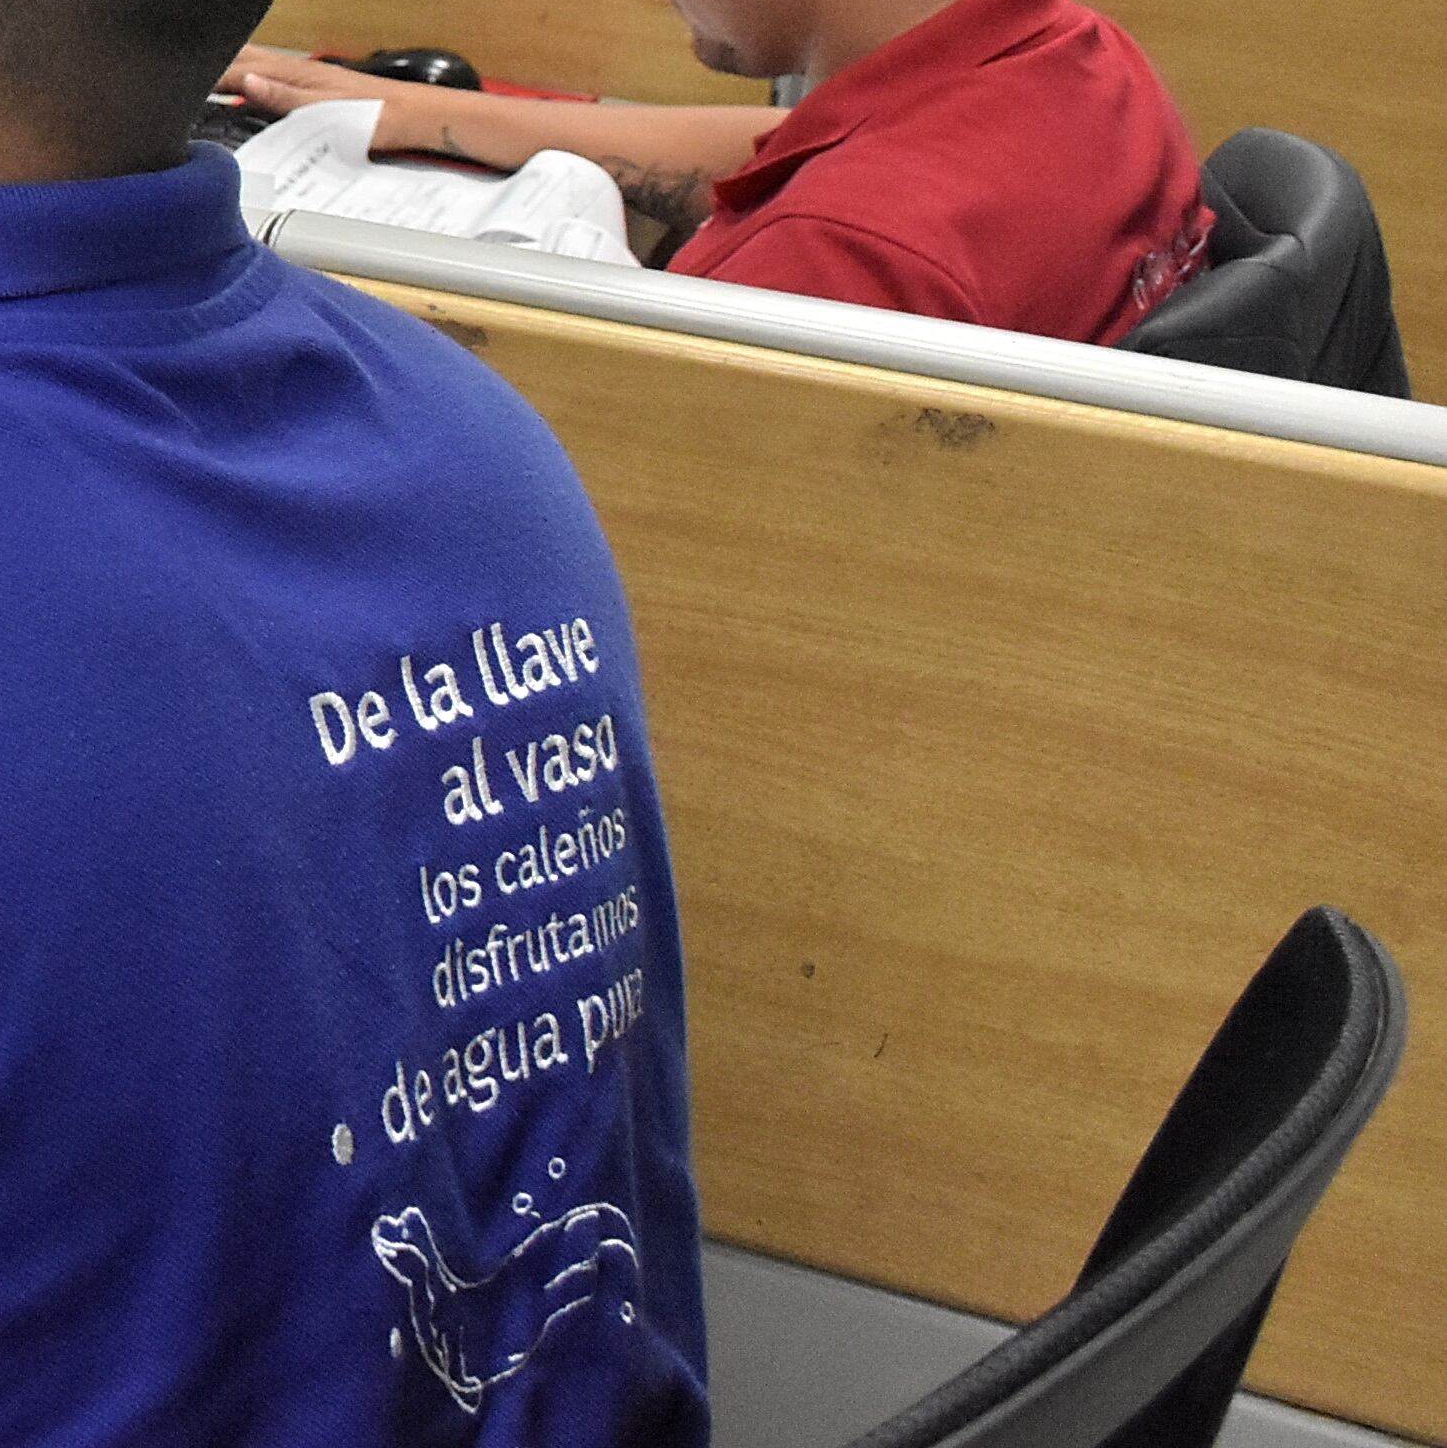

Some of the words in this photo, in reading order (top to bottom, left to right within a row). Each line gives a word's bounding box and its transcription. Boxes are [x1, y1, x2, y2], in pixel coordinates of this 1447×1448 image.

[311, 688, 400, 766] De
[400, 654, 472, 733] la
[472, 615, 601, 708] llave
[443, 736, 504, 826] al
[505, 712, 619, 804] vaso
[420, 857, 481, 925] los
[495, 802, 627, 896] caleños
[433, 881, 640, 1009] disfrutamos
[382, 1061, 435, 1145] de
[442, 1010, 570, 1113] agua
